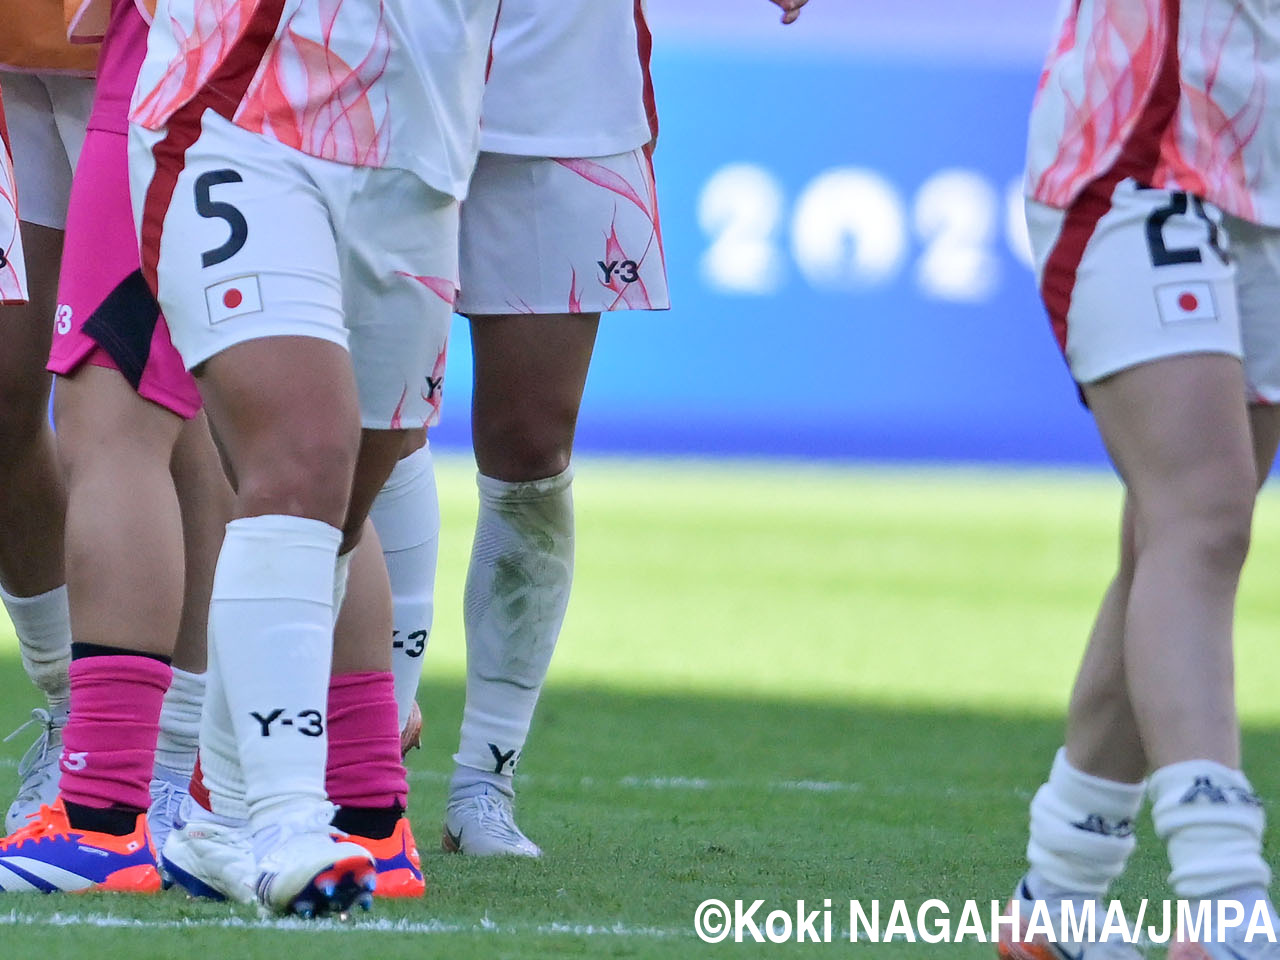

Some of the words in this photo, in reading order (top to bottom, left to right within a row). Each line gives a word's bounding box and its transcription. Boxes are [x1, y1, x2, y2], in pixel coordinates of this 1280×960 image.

[194, 168, 249, 269] 5
[597, 259, 639, 284] Y-3
[424, 375, 443, 399] Y-
[249, 708, 324, 737] Y-3
[487, 742, 521, 774] Y-
